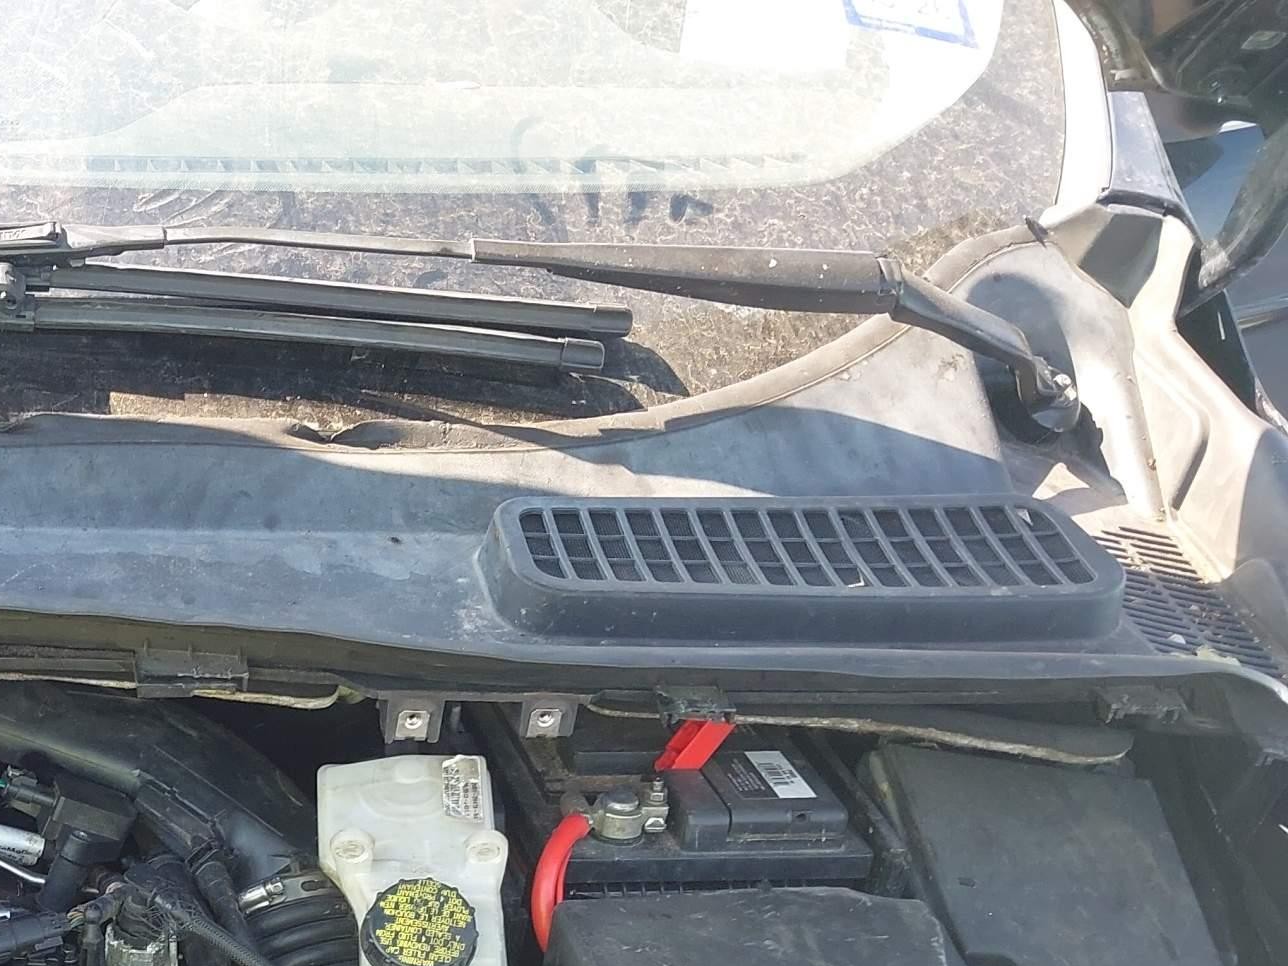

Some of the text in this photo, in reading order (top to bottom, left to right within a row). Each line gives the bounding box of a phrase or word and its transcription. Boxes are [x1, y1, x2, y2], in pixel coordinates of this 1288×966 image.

[448, 897, 462, 905] DOT
[419, 914, 428, 922] LE
[376, 929, 394, 938] FROM
[398, 932, 417, 941] FLUID
[425, 930, 451, 940] SEALED
[430, 938, 444, 946] DOT
[448, 940, 465, 950] ONLY
[385, 946, 451, 963] CLEAN FILLER CAP
[434, 945, 459, 957] BEFORE
